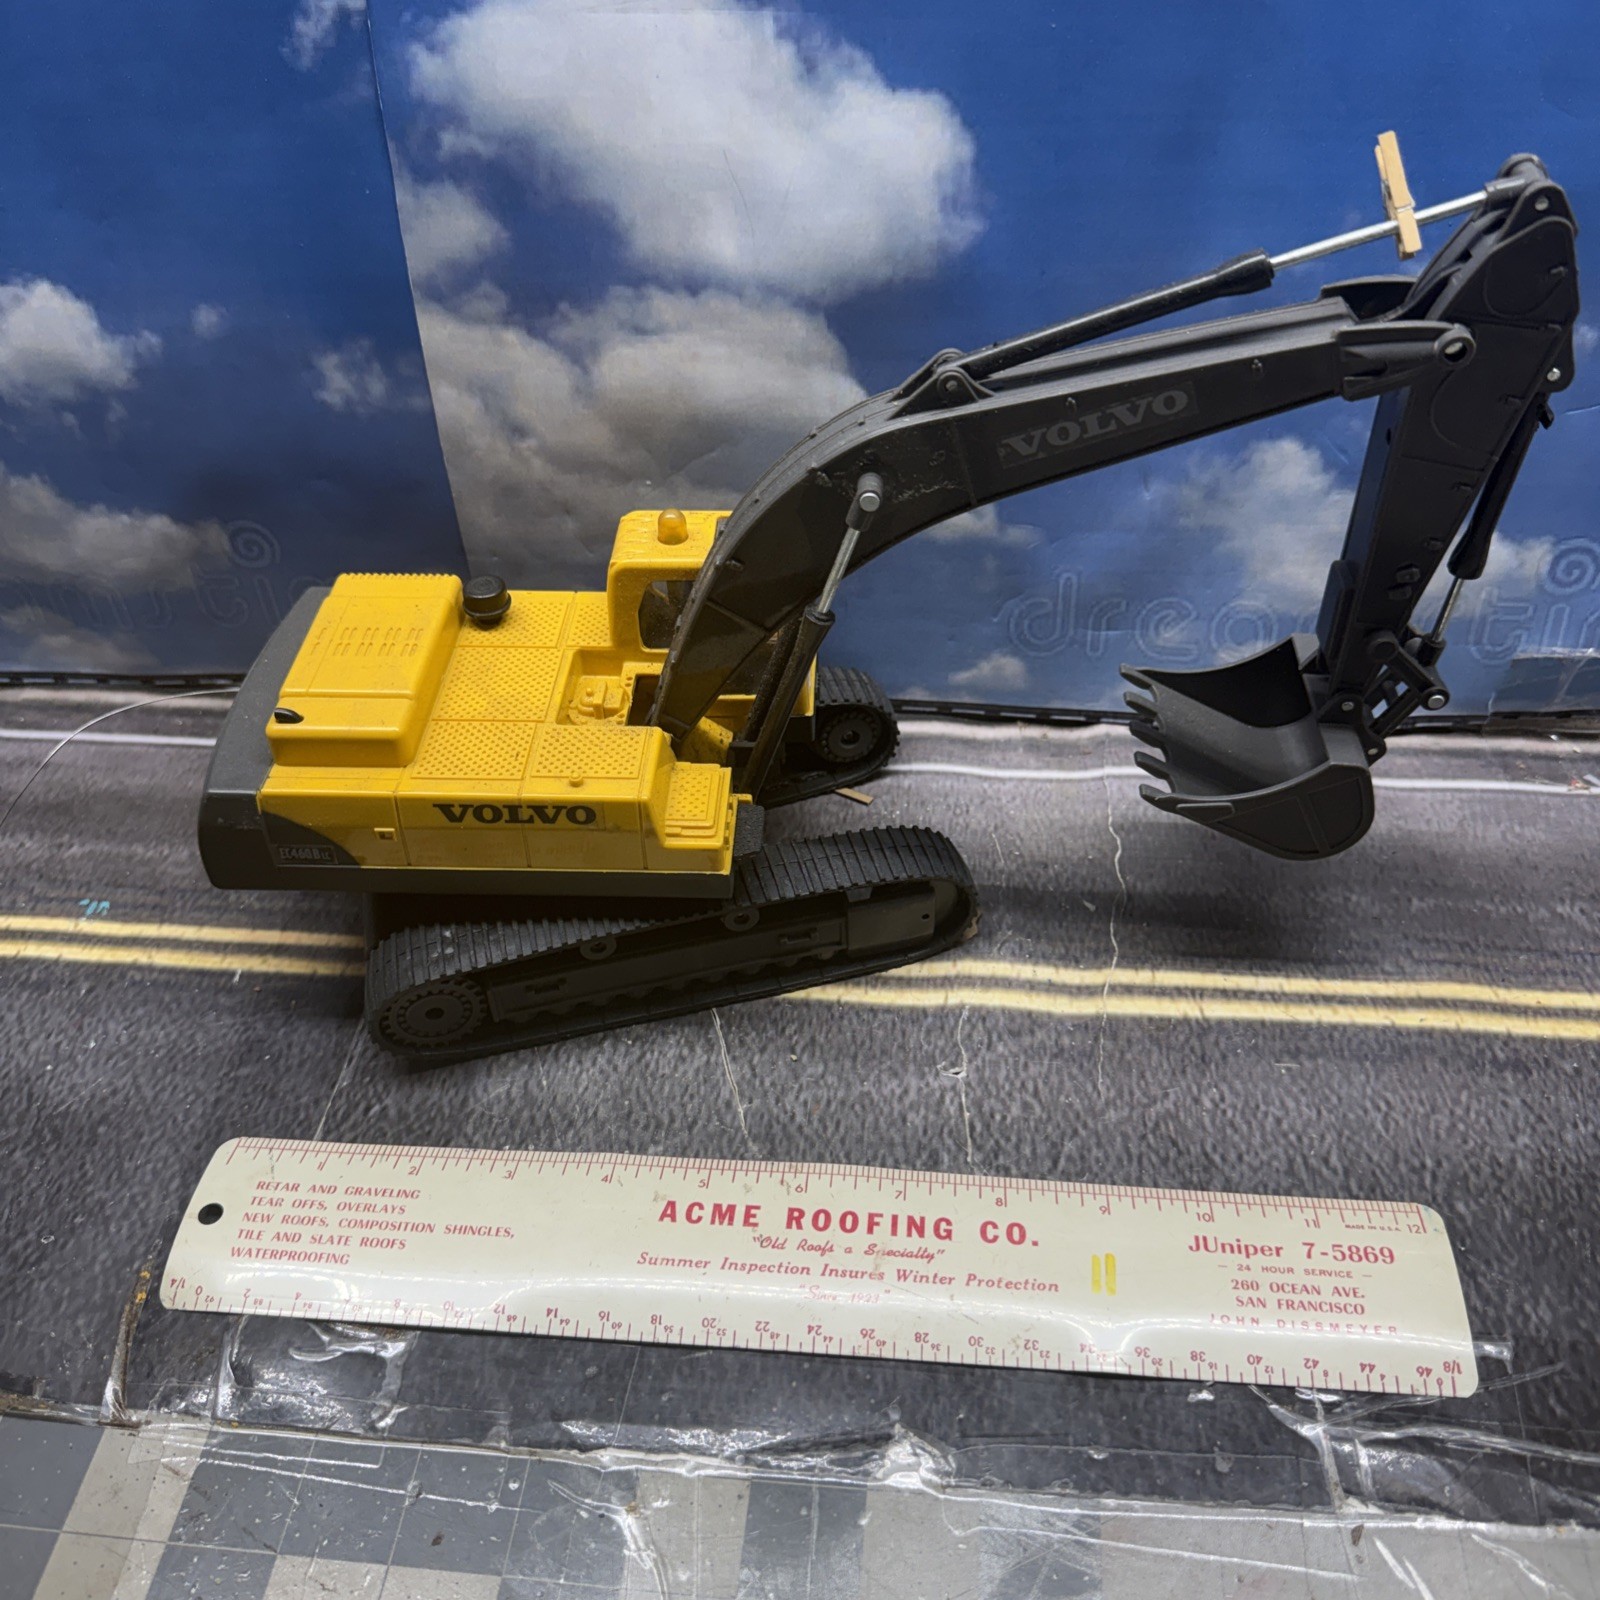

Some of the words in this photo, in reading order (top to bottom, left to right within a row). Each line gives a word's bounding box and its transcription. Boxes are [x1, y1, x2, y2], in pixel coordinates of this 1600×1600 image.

[1002, 390, 1189, 458] VOLVO
[432, 803, 598, 825] VOLVO
[255, 1180, 301, 1193] RETAR
[307, 1183, 337, 1195] AND
[344, 1185, 421, 1200] GRAVELING
[250, 1196, 285, 1207] TEAR
[291, 1198, 328, 1211] OFFS,
[336, 1201, 406, 1215] OVERLAYS
[408, 1166, 418, 1176] 2
[503, 1170, 513, 1179] 3
[601, 1175, 610, 1183] 4
[698, 1178, 707, 1188] 5
[795, 1183, 804, 1193] 6
[895, 1190, 903, 1200] 7
[995, 1198, 1004, 1207] 8
[1099, 1205, 1108, 1215] 9
[1197, 1212, 1211, 1222] 10
[1304, 1219, 1317, 1228] 11
[1407, 1224, 1422, 1234] 12
[242, 1212, 274, 1224] NEW
[280, 1214, 329, 1229] ROOFS,
[338, 1217, 435, 1233] COMPOSITION
[443, 1224, 515, 1239] SHINGLES,
[658, 1200, 762, 1228] ACME
[785, 1207, 953, 1241] ROOFING
[979, 1220, 1039, 1247] CO.
[237, 1228, 263, 1240] TILE
[270, 1231, 303, 1243] AND
[308, 1234, 352, 1247] SLATE
[359, 1237, 407, 1250] ROOFS
[796, 1238, 835, 1257] Roofs
[844, 1246, 853, 1254] a
[1188, 1235, 1284, 1260] JUniper
[1301, 1241, 1395, 1265] 7-5869
[230, 1246, 350, 1265] WATERPROOFING
[636, 1252, 711, 1269] Summer
[720, 1257, 811, 1276] Inspection
[821, 1263, 885, 1281] Insures
[896, 1268, 956, 1285] Winter
[965, 1273, 1059, 1293] Protection
[1236, 1263, 1252, 1272] 24
[1260, 1265, 1295, 1275] HOUR
[1303, 1268, 1353, 1279] SERVICE
[195, 1285, 203, 1296] 0
[243, 1288, 251, 1298] 2
[1231, 1279, 1260, 1292] 260
[1269, 1282, 1321, 1296] OCEAN
[1331, 1286, 1365, 1299] AVE.
[493, 1303, 506, 1315] 12
[1235, 1296, 1267, 1309] SAN
[1277, 1298, 1365, 1315] FRANCISCO
[546, 1307, 559, 1318] 14
[599, 1310, 610, 1322] 16
[559, 1318, 571, 1326] 64
[611, 1321, 622, 1330] 60
[651, 1314, 662, 1325] 18
[702, 1317, 717, 1328] 20
[1209, 1313, 1260, 1327] JOHN
[1277, 1318, 1398, 1335] DISSMEYER
[663, 1325, 674, 1333] 56
[716, 1328, 727, 1336] 52
[755, 1321, 770, 1332] 22
[807, 1324, 822, 1336] 24
[770, 1332, 781, 1340] 48
[823, 1335, 834, 1344] 44
[860, 1328, 875, 1340] 26
[914, 1332, 929, 1343] 28
[876, 1339, 887, 1347] 40
[930, 1343, 941, 1351] 36
[968, 1335, 984, 1347] 30
[1024, 1339, 1039, 1351] 32
[985, 1346, 996, 1355] 32
[1134, 1346, 1151, 1359] 36
[1190, 1350, 1206, 1363] 38
[1151, 1357, 1163, 1366] 20
[1208, 1362, 1218, 1370] 16
[1246, 1354, 1263, 1366] 40
[1303, 1357, 1320, 1369] 42
[1264, 1366, 1274, 1374] 12
[1359, 1362, 1376, 1374] 44
[1416, 1366, 1433, 1377] 46
